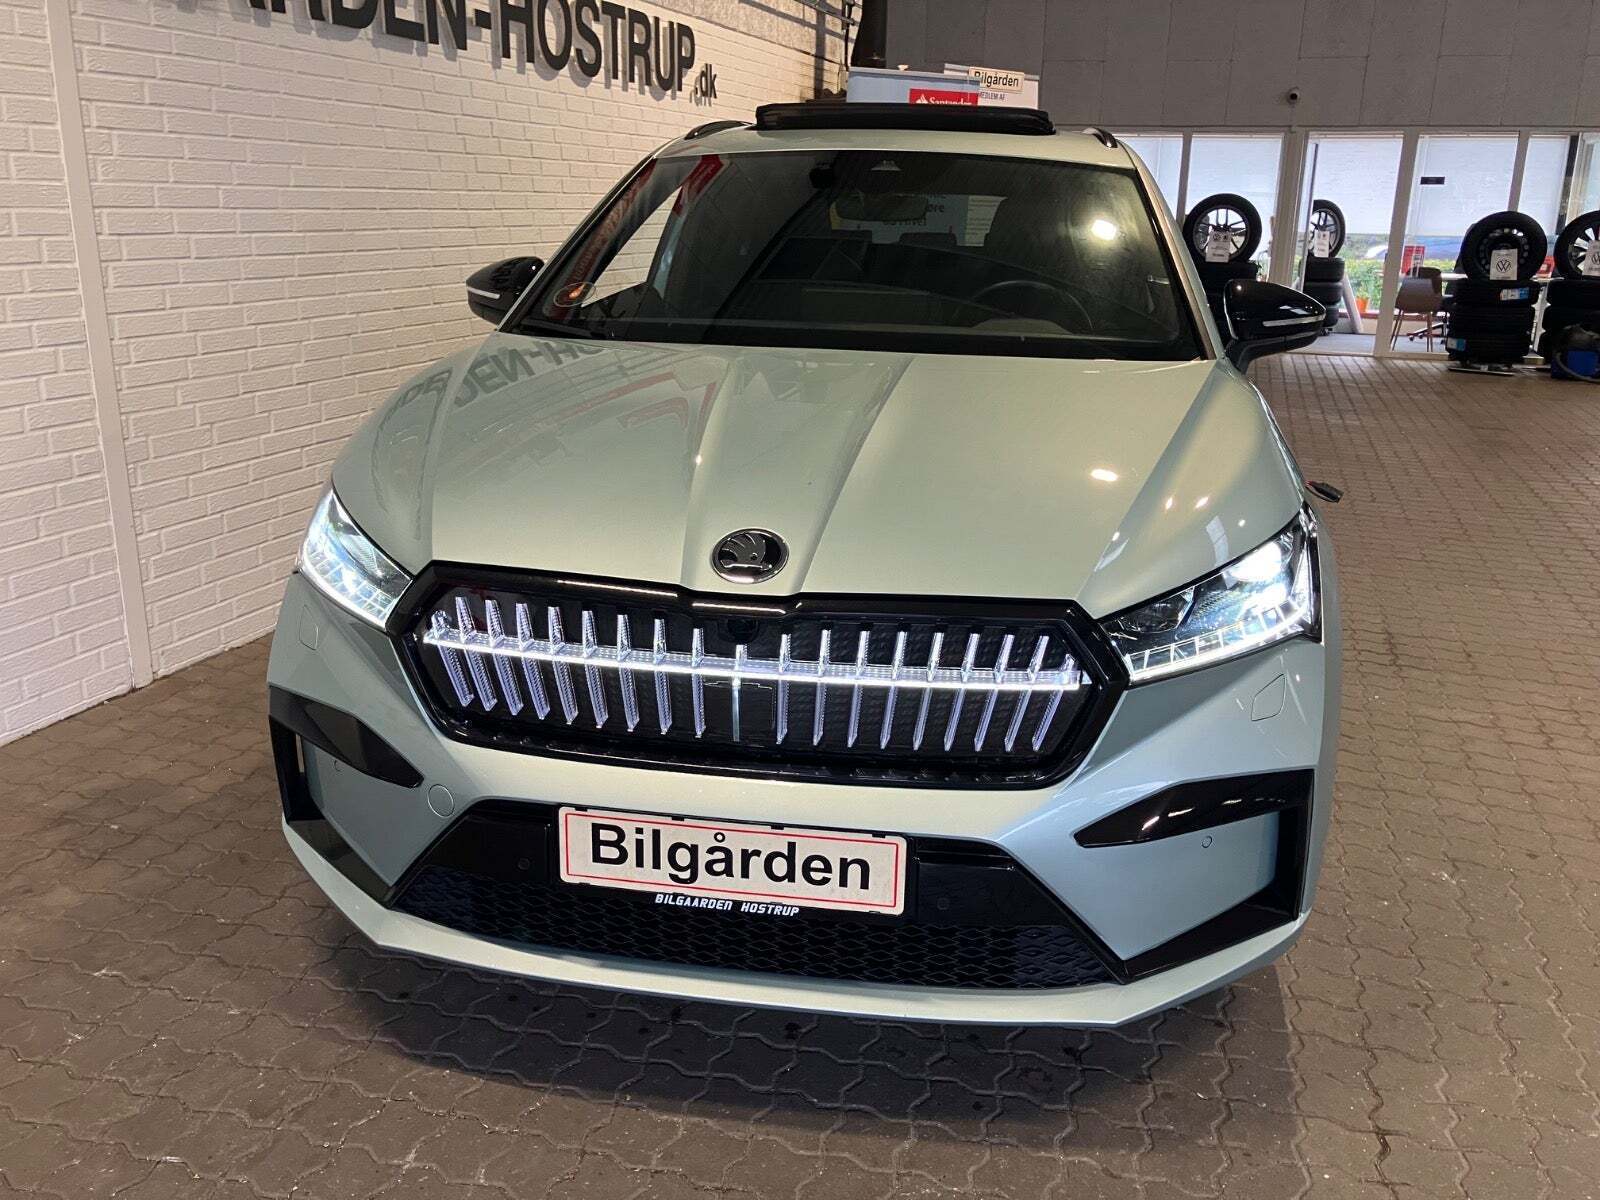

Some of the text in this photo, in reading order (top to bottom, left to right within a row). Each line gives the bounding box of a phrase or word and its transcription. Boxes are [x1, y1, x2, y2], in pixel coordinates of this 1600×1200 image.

[590, 822, 871, 890] Bilgården
[655, 893, 800, 917] BILGAARDEN HOSTRUP
